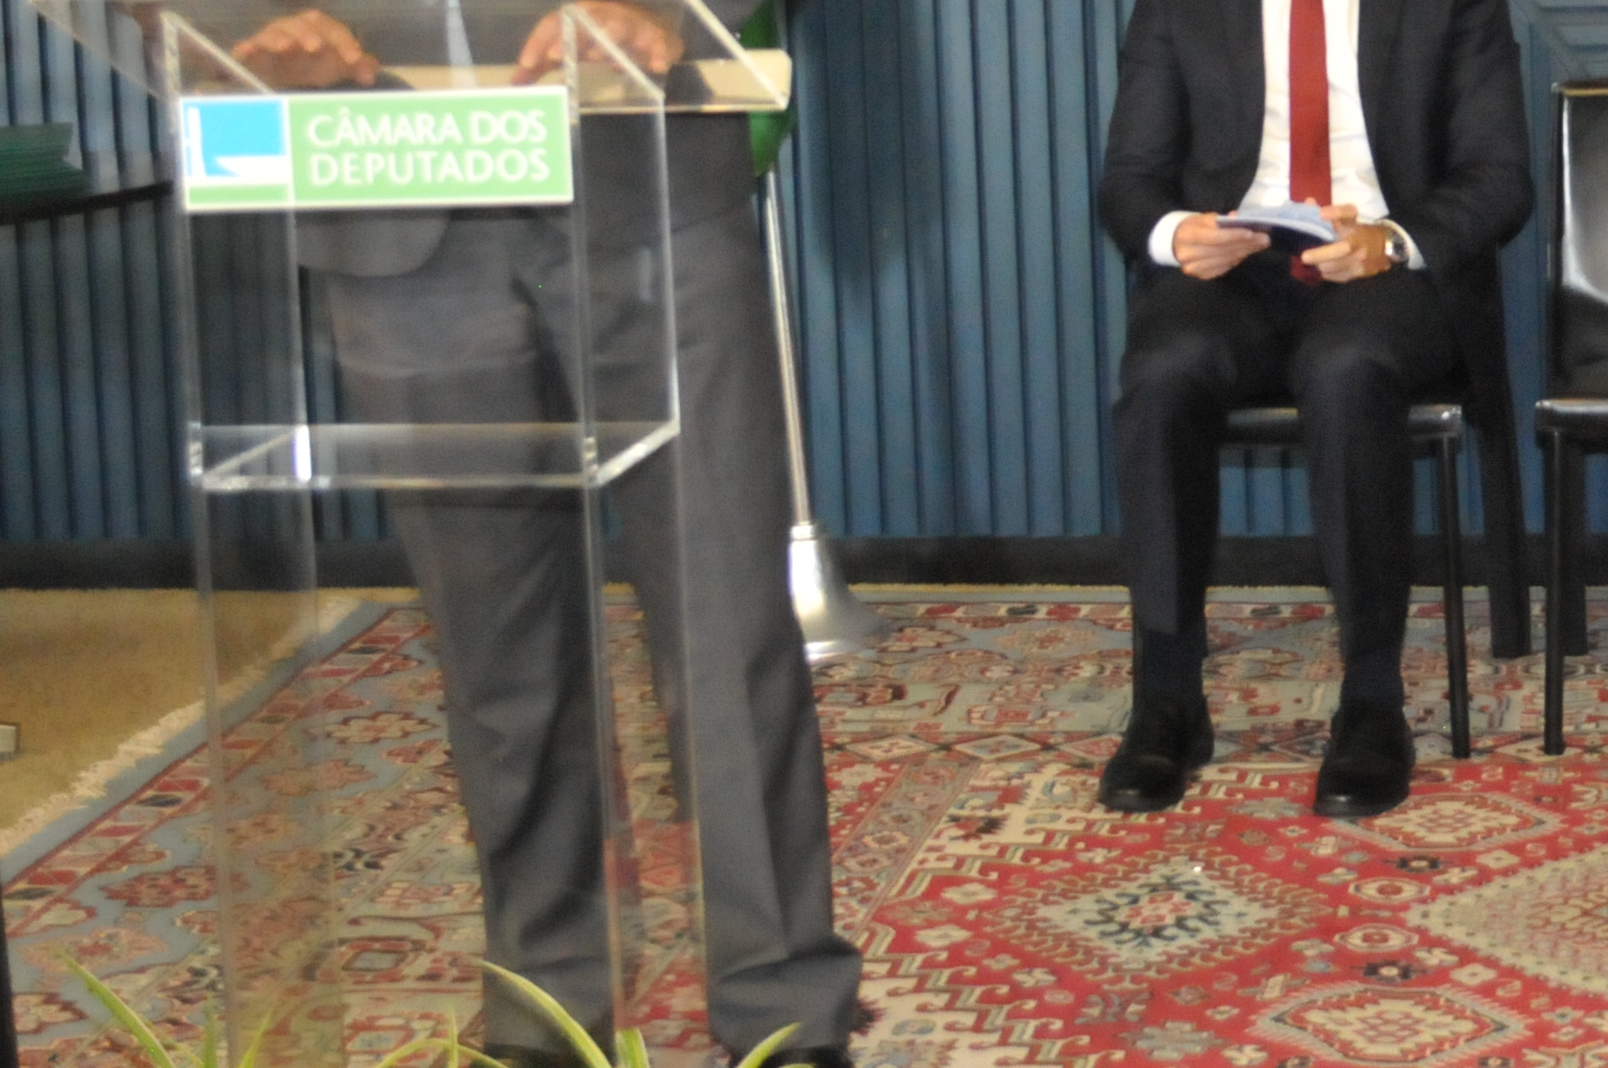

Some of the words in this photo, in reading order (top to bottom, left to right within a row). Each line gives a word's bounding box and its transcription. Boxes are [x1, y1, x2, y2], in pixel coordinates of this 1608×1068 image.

[308, 107, 463, 148] CÂMARA
[470, 109, 547, 144] DOS
[311, 148, 550, 186] DEPUTADOS
